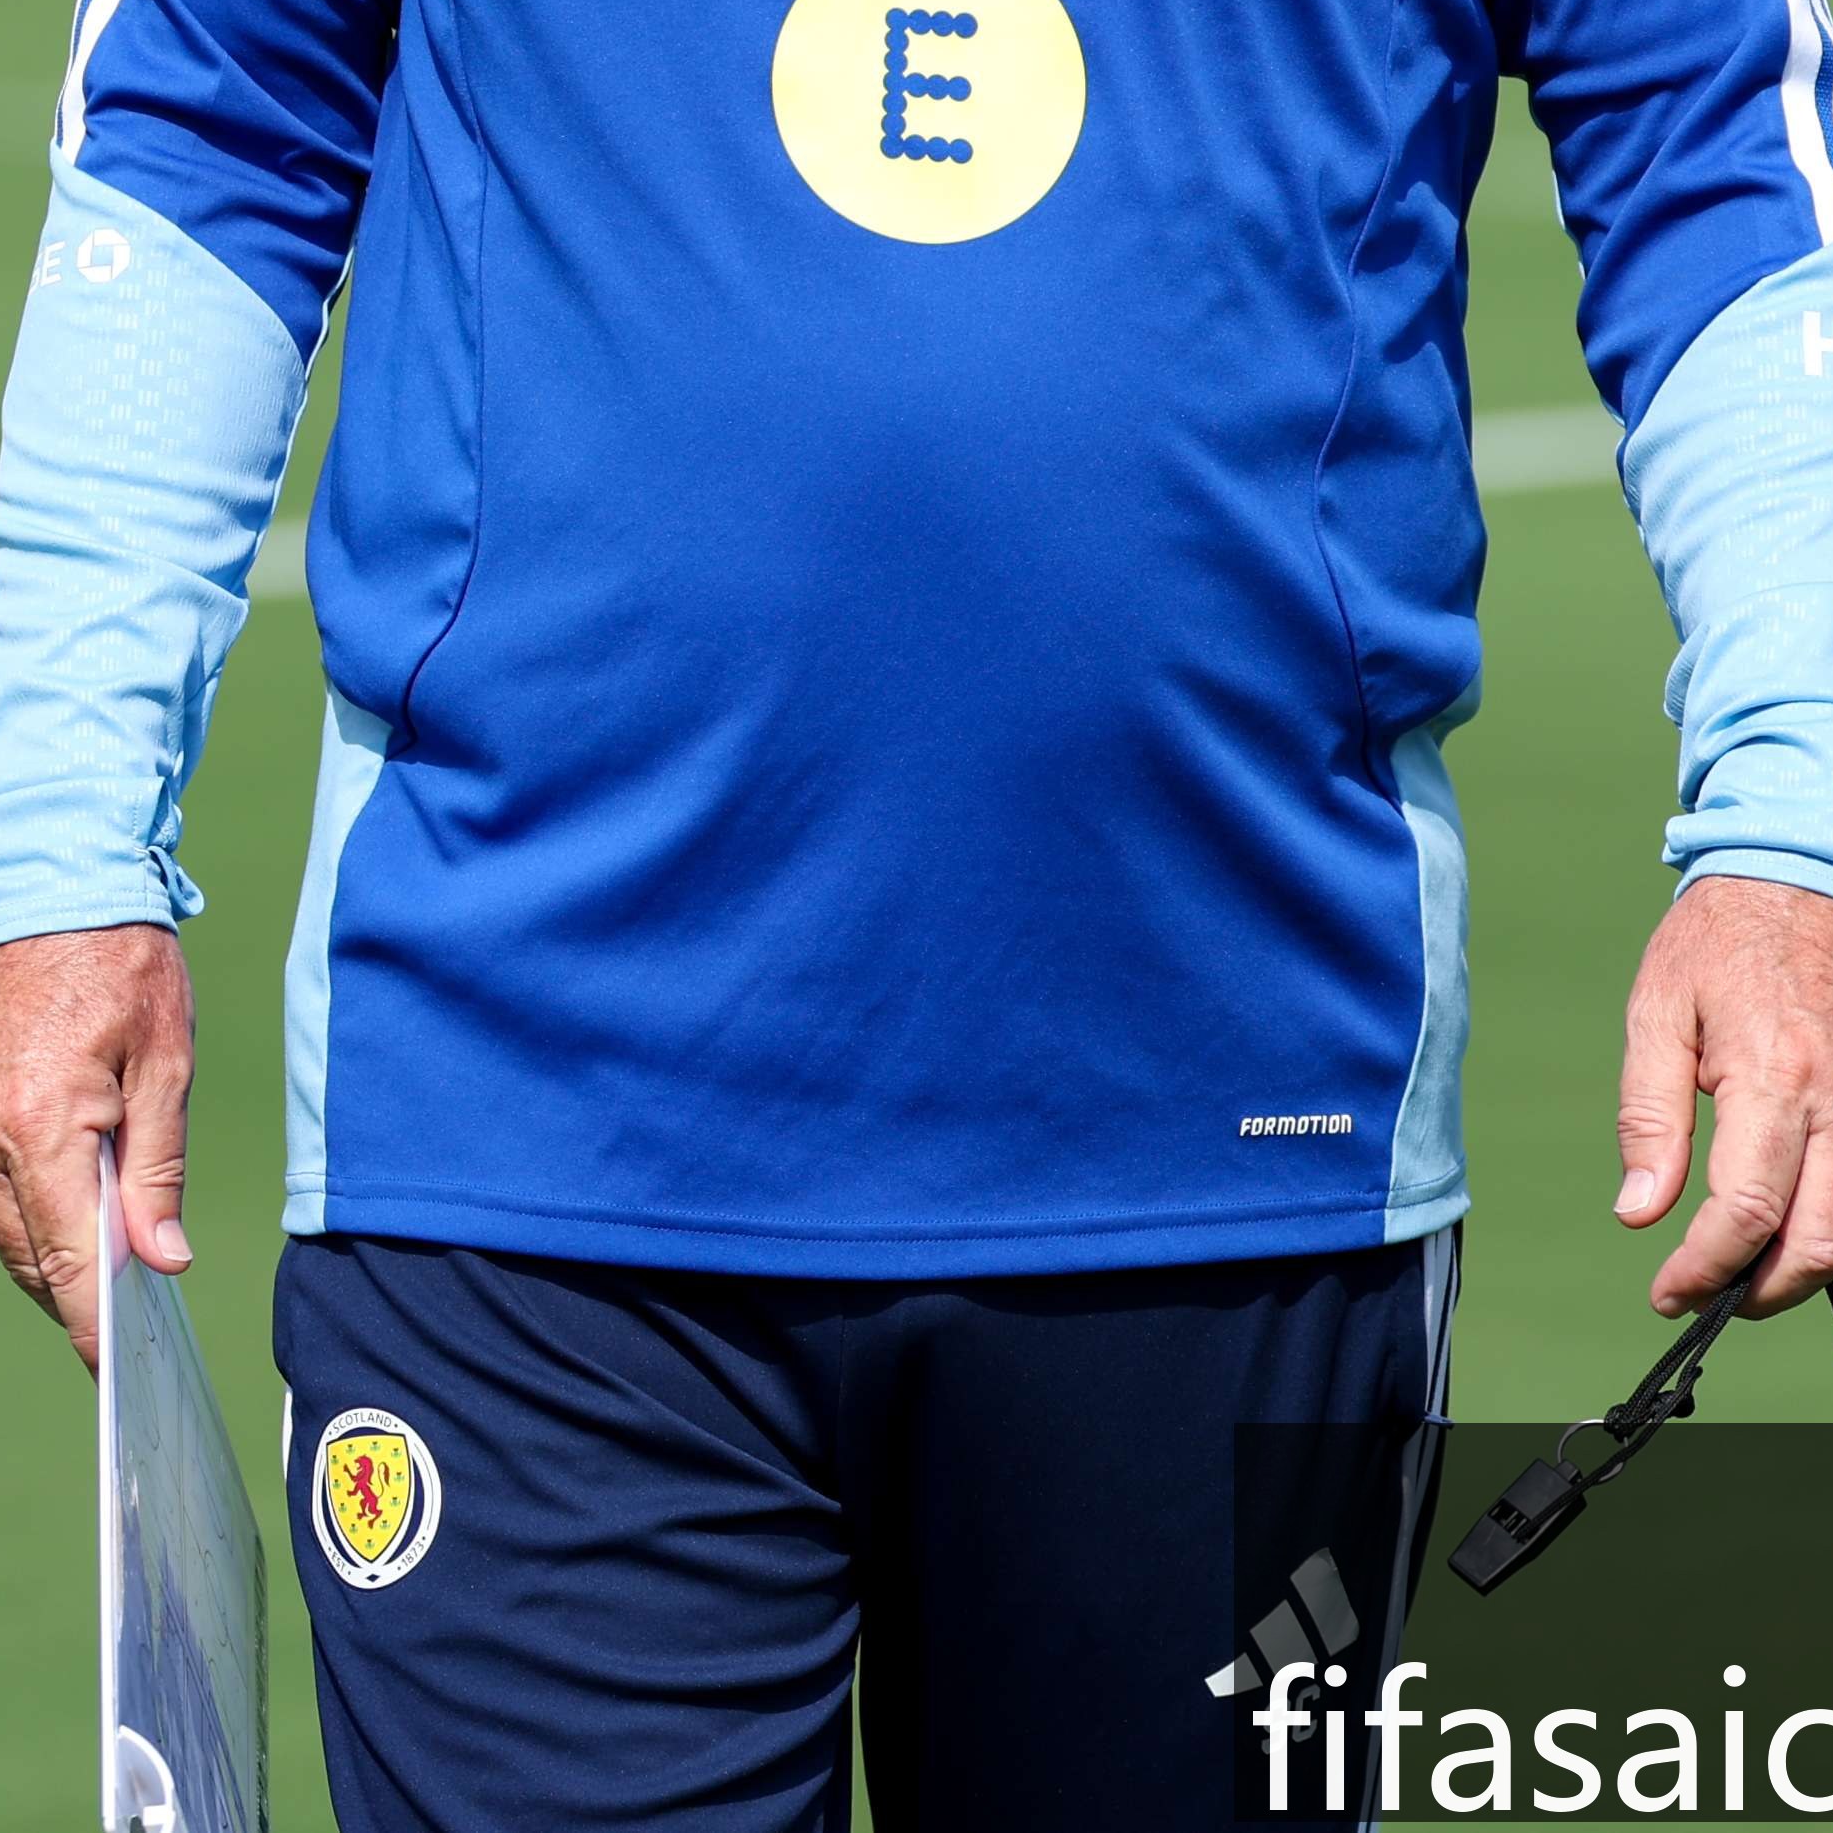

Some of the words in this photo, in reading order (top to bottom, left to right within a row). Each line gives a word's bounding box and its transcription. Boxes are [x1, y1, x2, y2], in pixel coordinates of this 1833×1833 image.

[28, 240, 66, 296] E
[1239, 1114, 1352, 1137] FORMOTION
[333, 1412, 392, 1434] SCOTLAND
[330, 1551, 346, 1573] EST
[400, 1541, 425, 1567] 1873
